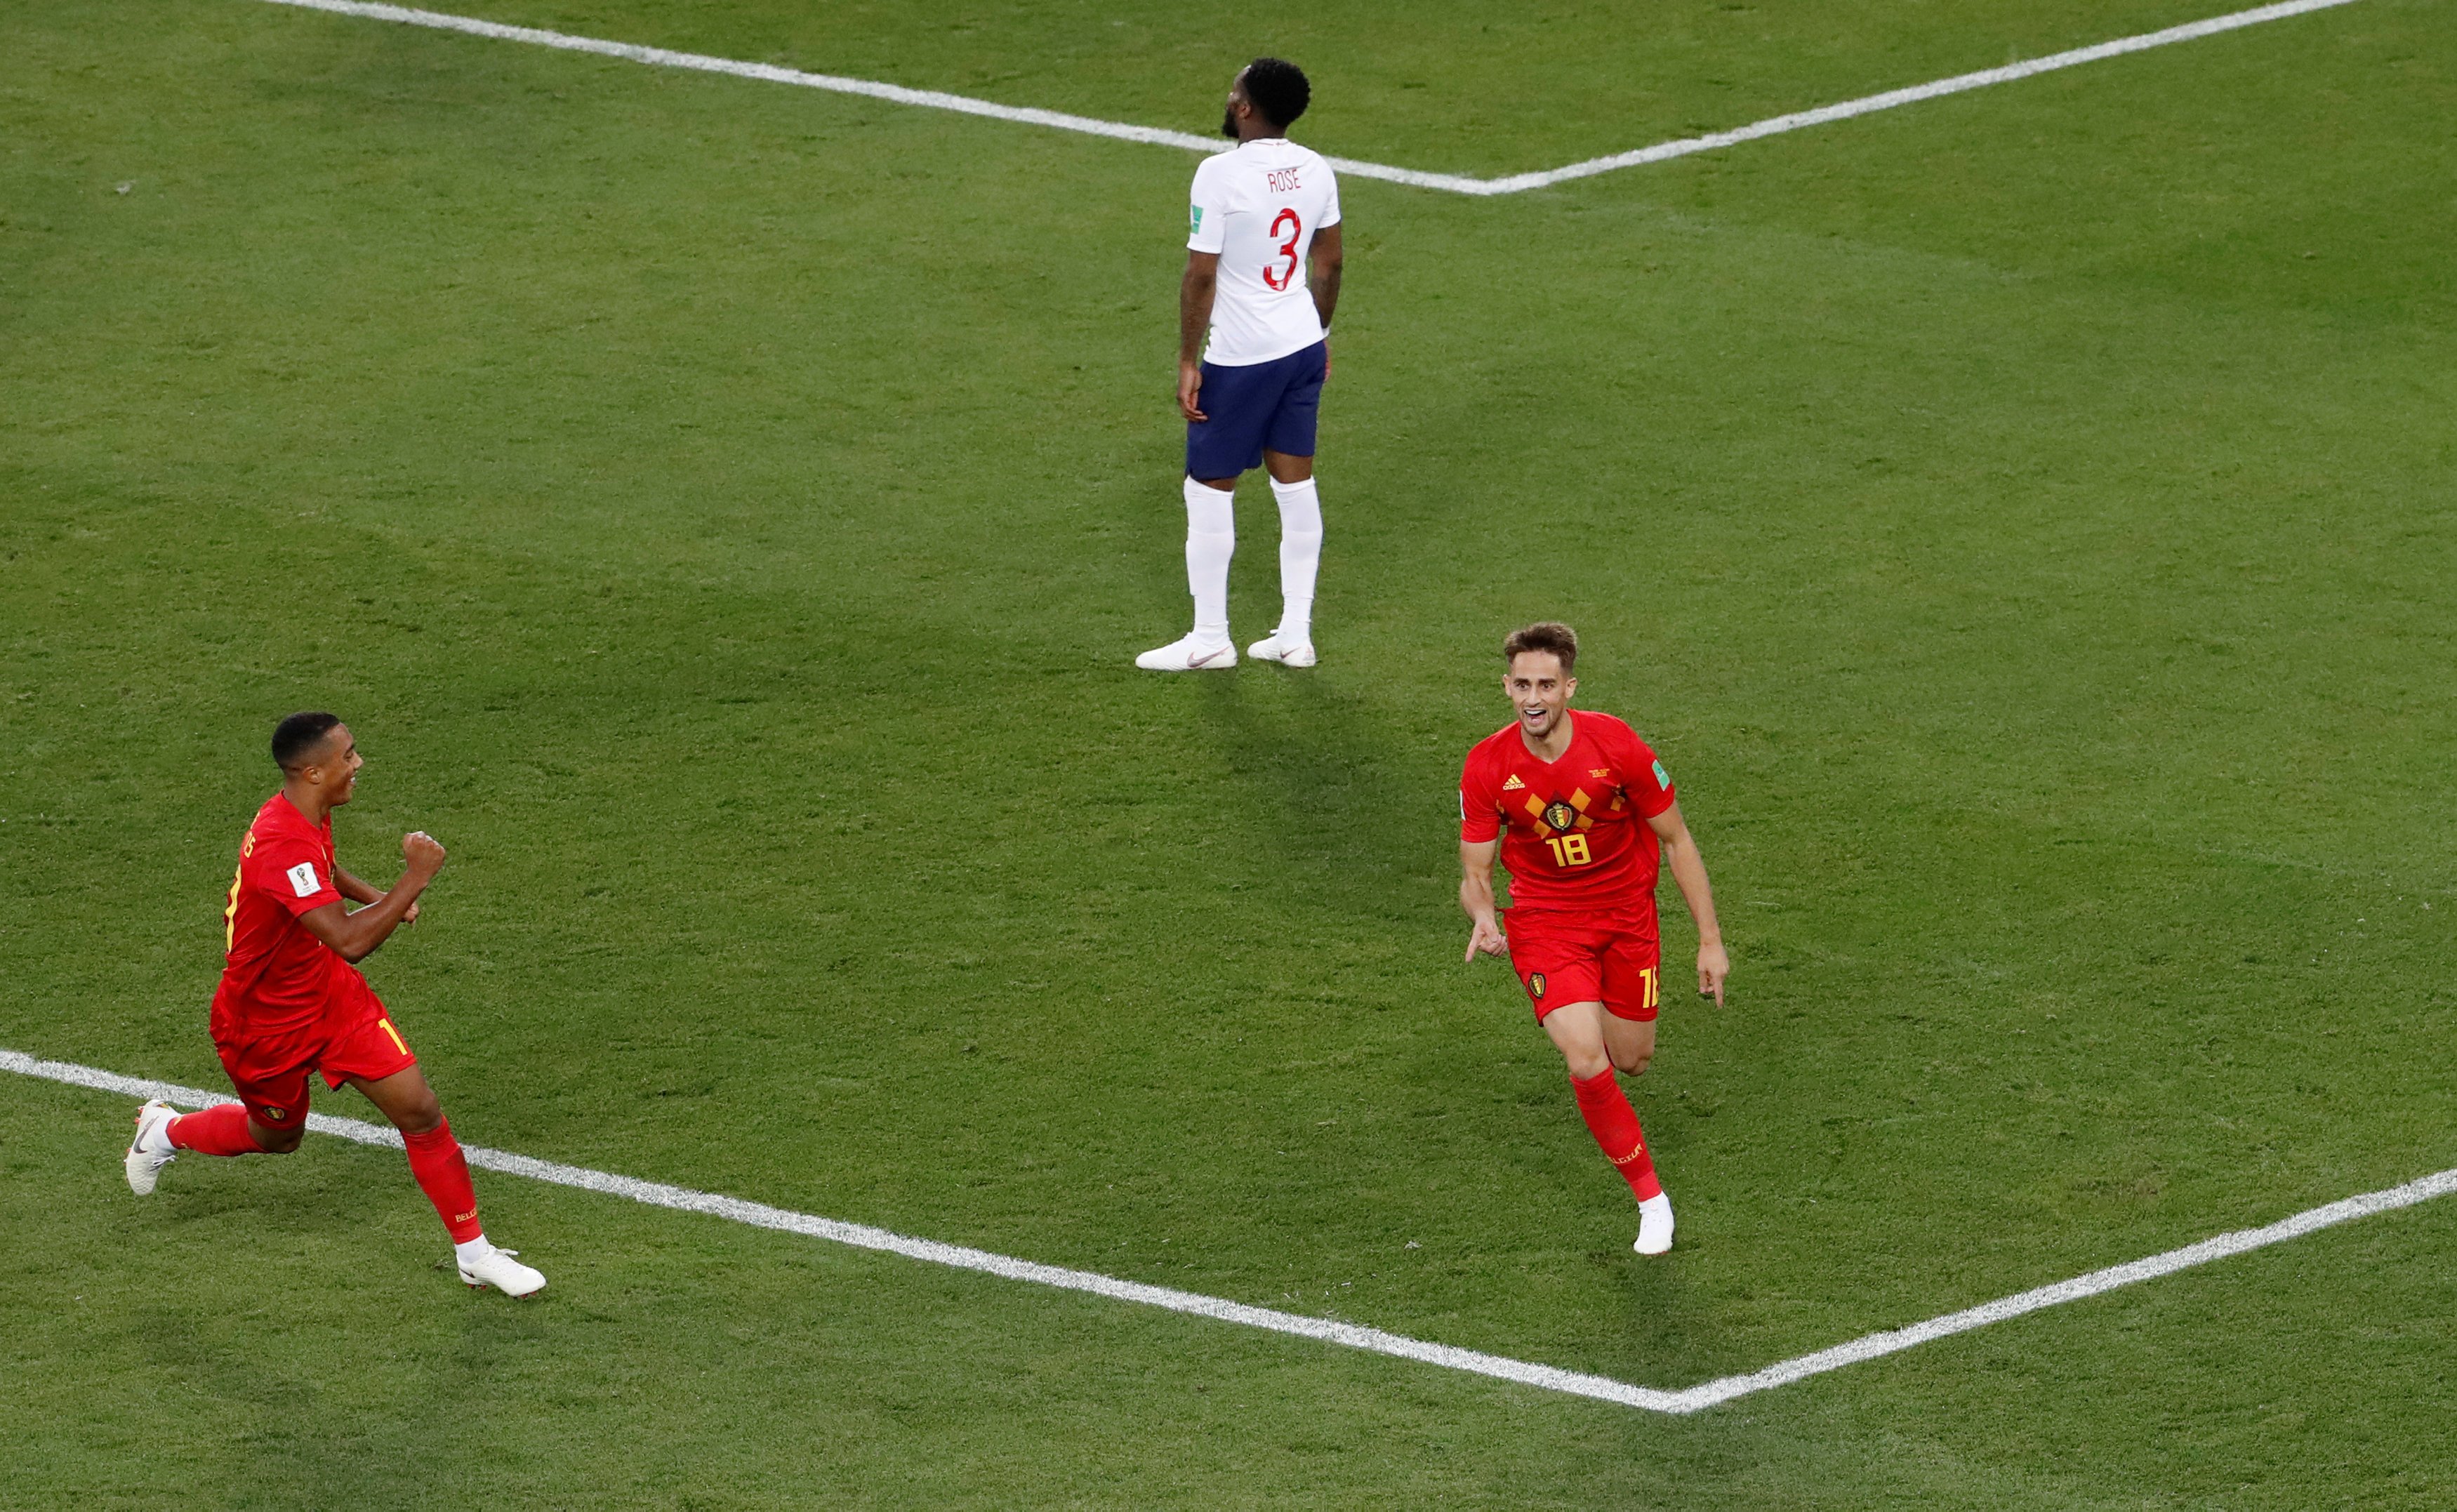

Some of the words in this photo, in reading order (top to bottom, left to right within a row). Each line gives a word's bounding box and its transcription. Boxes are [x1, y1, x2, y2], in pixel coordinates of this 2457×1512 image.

[1267, 168, 1301, 193] ROSE
[1263, 208, 1302, 292] 3
[1545, 833, 1592, 868] 18
